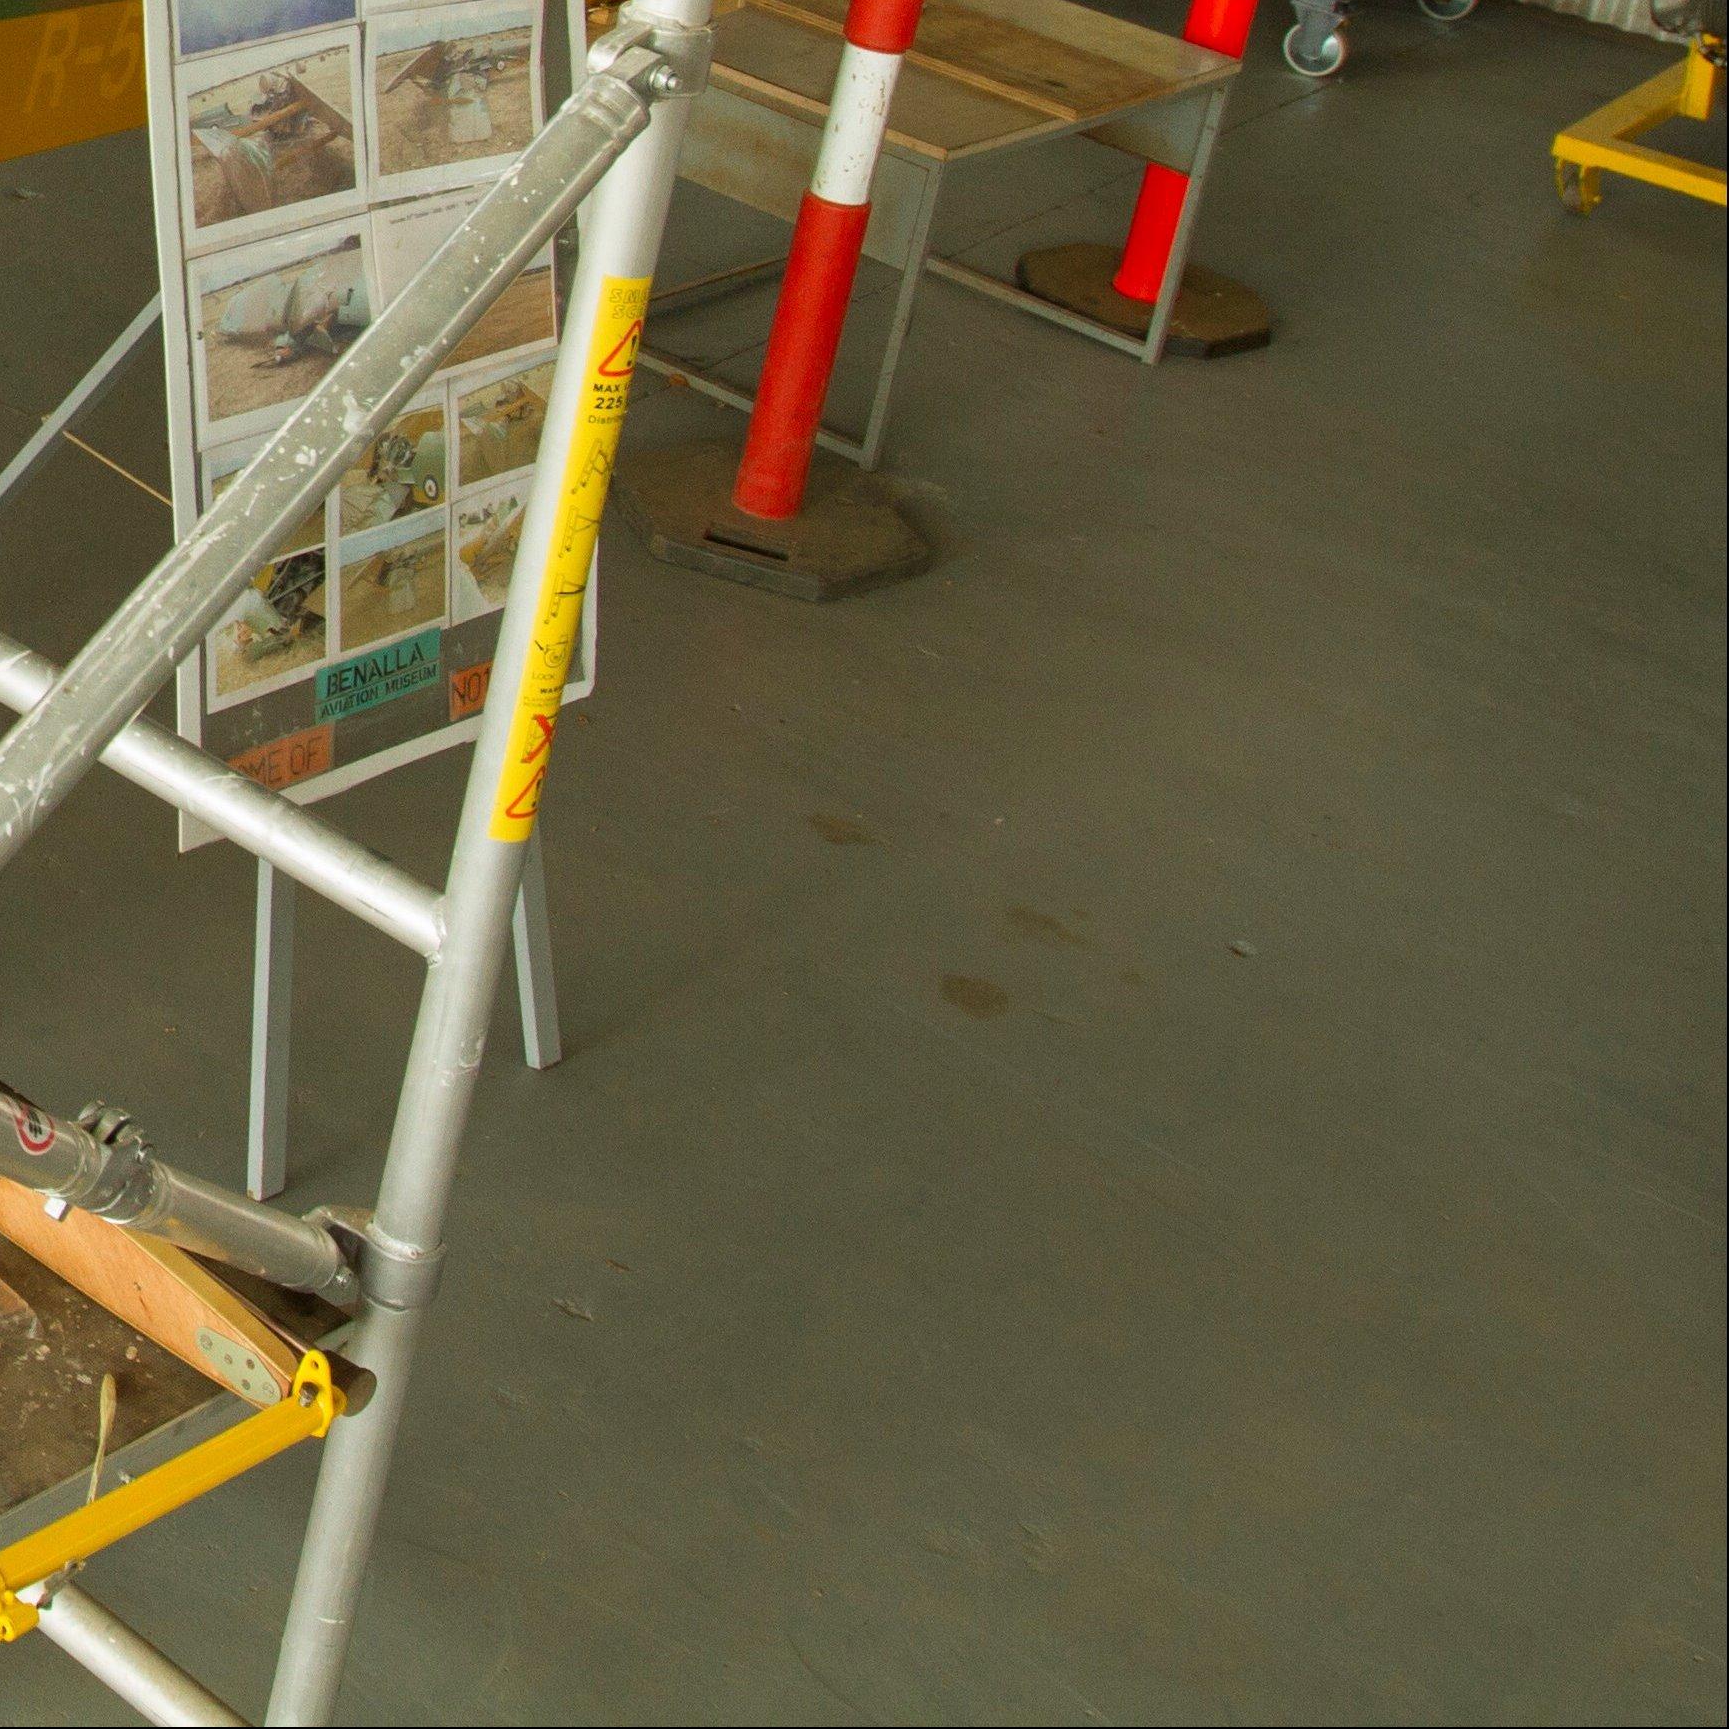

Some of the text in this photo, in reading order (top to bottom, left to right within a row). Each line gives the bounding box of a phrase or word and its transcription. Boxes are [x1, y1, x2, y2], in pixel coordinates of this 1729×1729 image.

[593, 383, 621, 393] MAX
[594, 396, 623, 410] 225
[327, 642, 424, 698] BENALLA
[321, 663, 438, 720] AVIATION MUSEUM
[289, 735, 324, 776] OF
